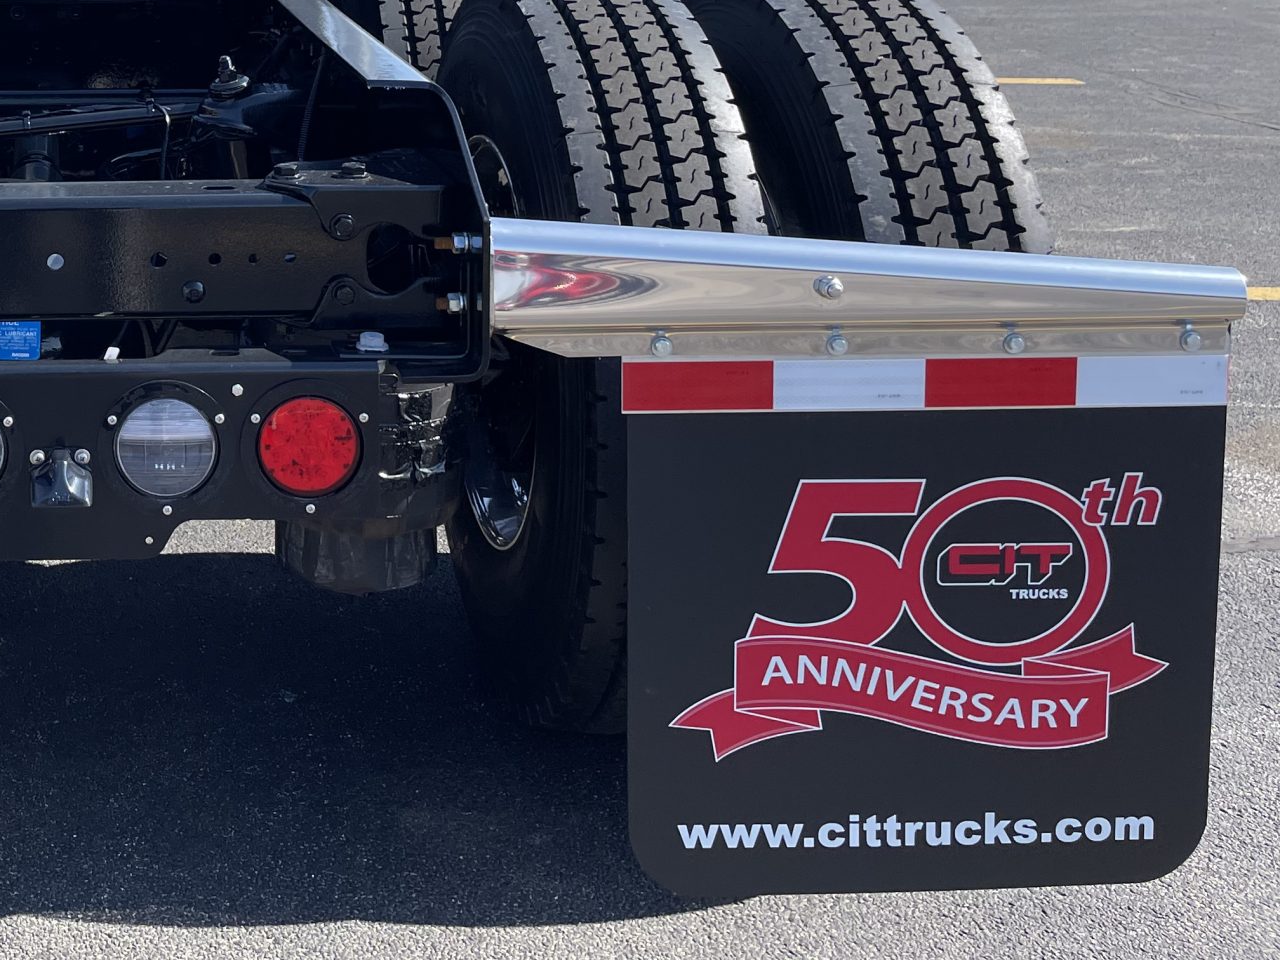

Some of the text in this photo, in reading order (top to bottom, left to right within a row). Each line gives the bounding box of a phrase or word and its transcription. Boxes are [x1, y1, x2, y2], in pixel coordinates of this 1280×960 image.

[937, 542, 1073, 586] CIT
[1010, 588, 1068, 600] TRUCKS
[761, 654, 1089, 730] ANNIVERSARY
[677, 812, 1154, 849] www.cittrucks.com
